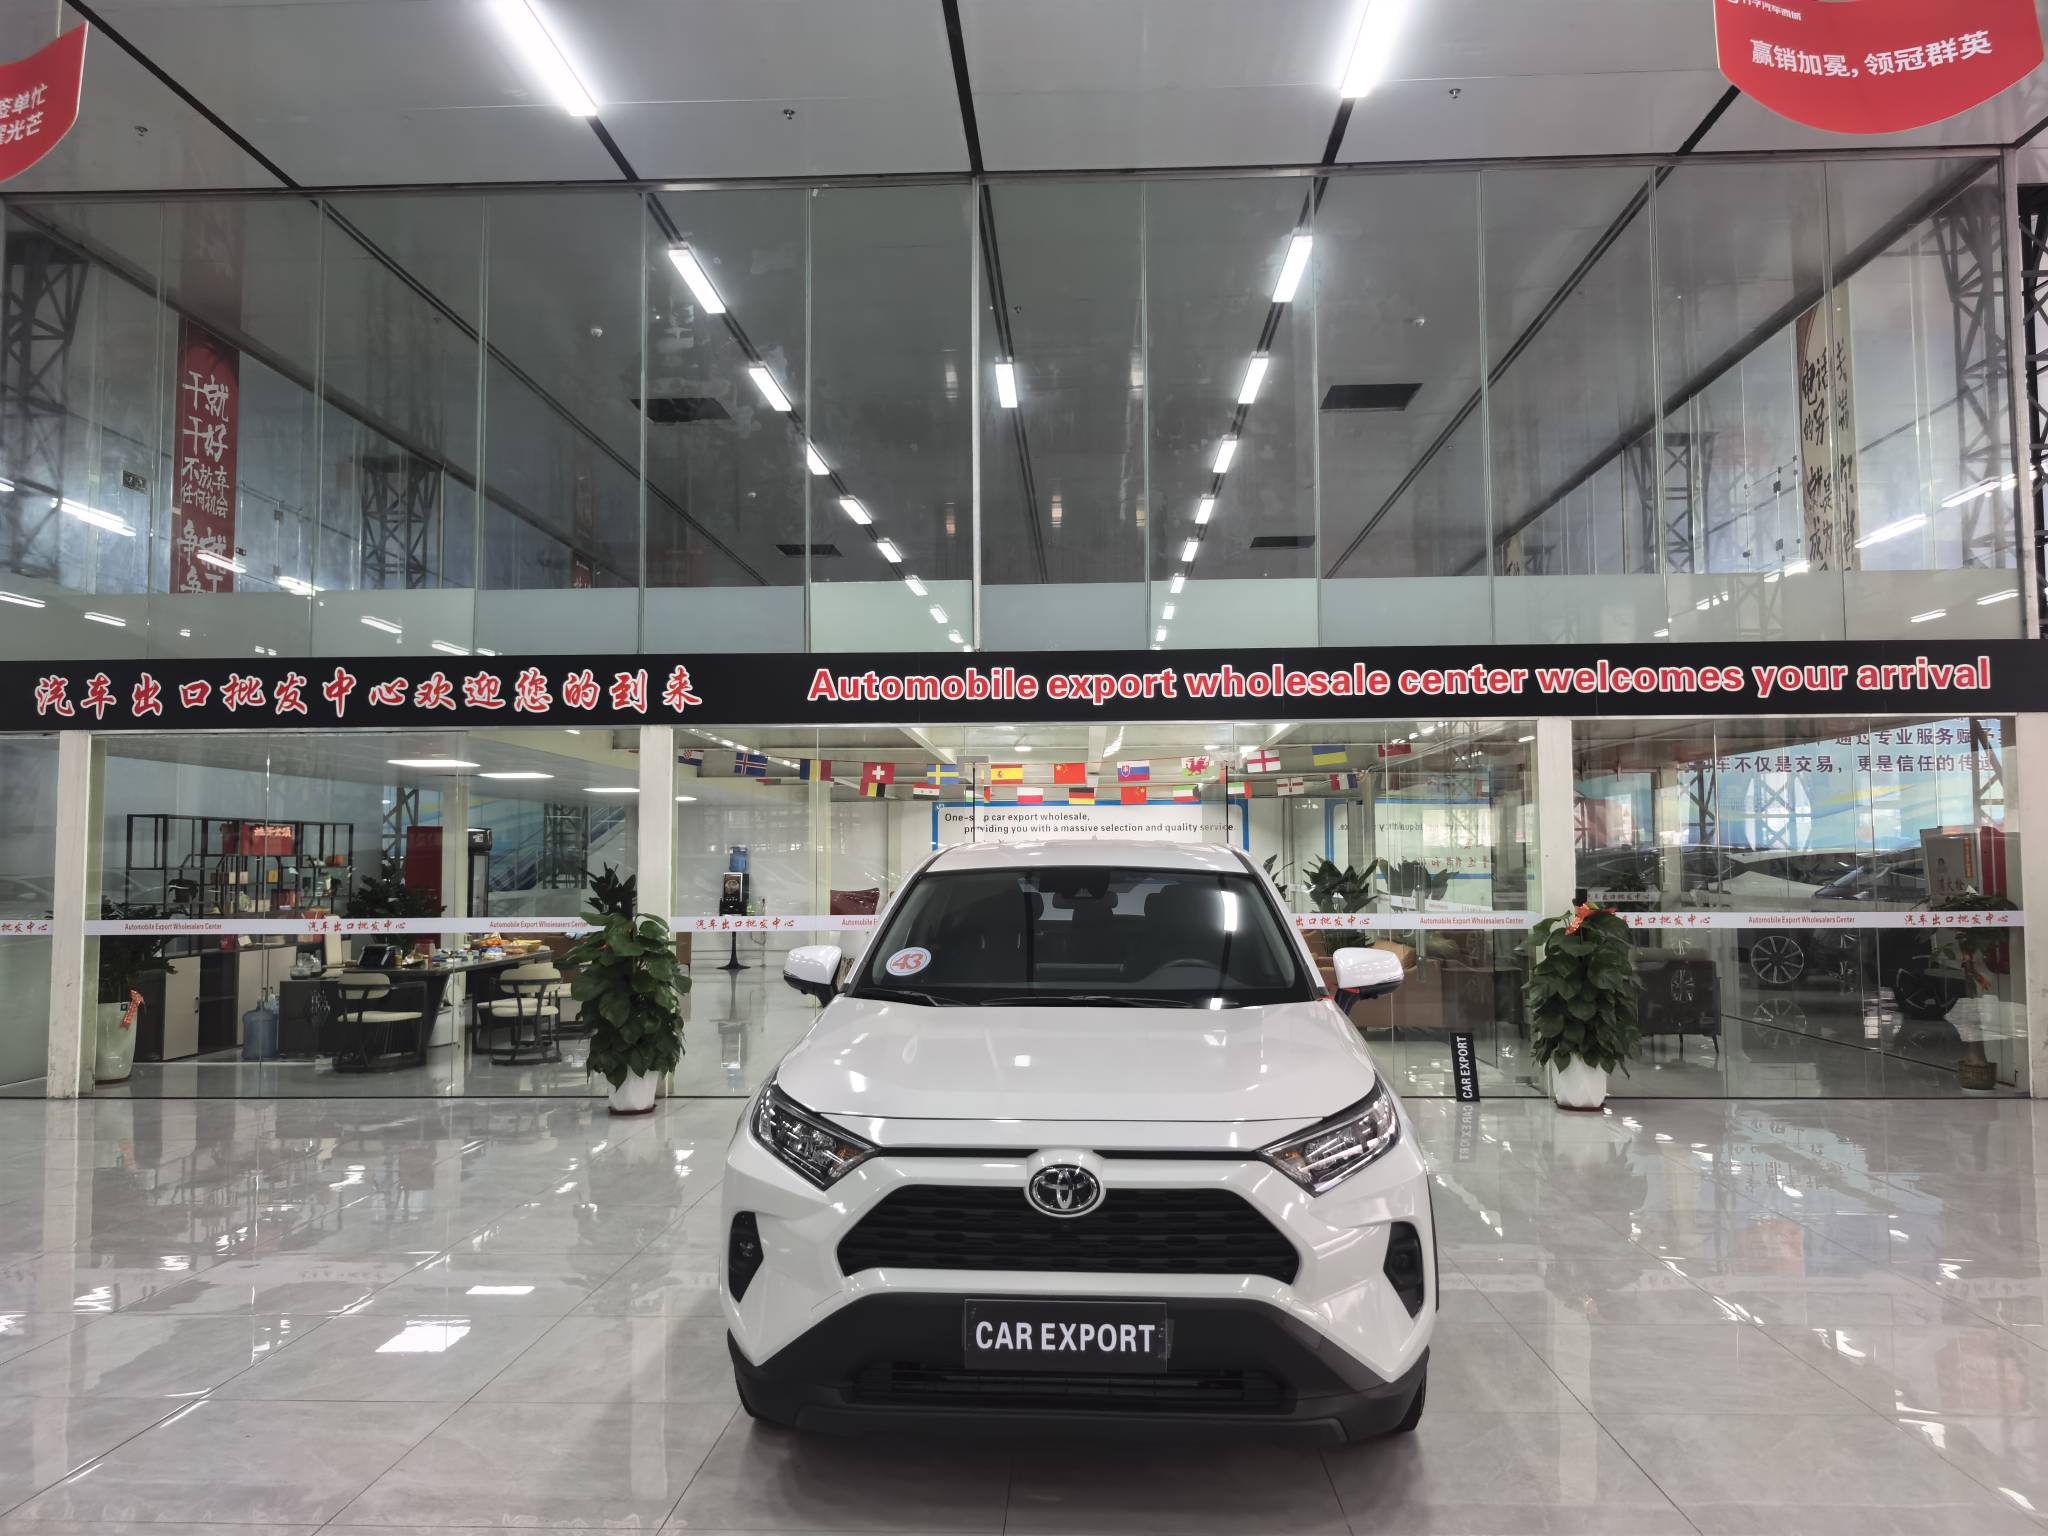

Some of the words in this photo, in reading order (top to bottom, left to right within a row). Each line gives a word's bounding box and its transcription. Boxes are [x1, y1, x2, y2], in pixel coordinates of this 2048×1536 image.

[807, 667, 1039, 701] Automobile
[1046, 667, 1178, 706] export
[1183, 663, 1391, 698] wholesale
[1398, 663, 1529, 695] center
[1535, 659, 1745, 693] welcomes
[1752, 664, 1850, 699] your
[1856, 656, 1992, 691] arrival
[35, 664, 703, 720] 汽车出口批发中心欢迎您的到来
[944, 813, 989, 823] One-sp
[1007, 813, 1038, 823] export
[1040, 812, 1090, 822] wholesale,
[1011, 826, 1028, 834] you
[1030, 824, 1051, 833] with
[1060, 823, 1099, 832] massive
[1100, 823, 1143, 832] selection
[1145, 823, 1163, 832] and
[1164, 823, 1198, 833] quality
[489, 920, 520, 929] Automobile
[520, 920, 538, 930] Export
[538, 920, 570, 929] Wholesalers
[695, 917, 796, 930] 汽车出口批发中心
[842, 918, 873, 927] Automobile
[1420, 917, 1452, 925] Automobile
[1452, 917, 1471, 926] Export
[1471, 916, 1505, 925] Wholesalers
[1505, 916, 1524, 925] Center
[1748, 916, 1781, 924] Automobile
[1781, 916, 1801, 925] Export
[1801, 915, 1836, 924] Wholesalers
[1836, 915, 1856, 924] Center
[1904, 912, 2009, 926] 汽车出口批发中心
[125, 922, 155, 931] Automobile
[155, 922, 172, 932] Export
[173, 922, 204, 931] Wholesalers
[204, 922, 222, 931] Center
[307, 920, 407, 932] 汽车出口批发中心
[890, 951, 926, 972] 43
[1456, 1035, 1471, 1076] EXPORT
[1461, 1078, 1473, 1099] CAR
[975, 1320, 1033, 1350] CAR
[1041, 1322, 1156, 1352] EXPORT
